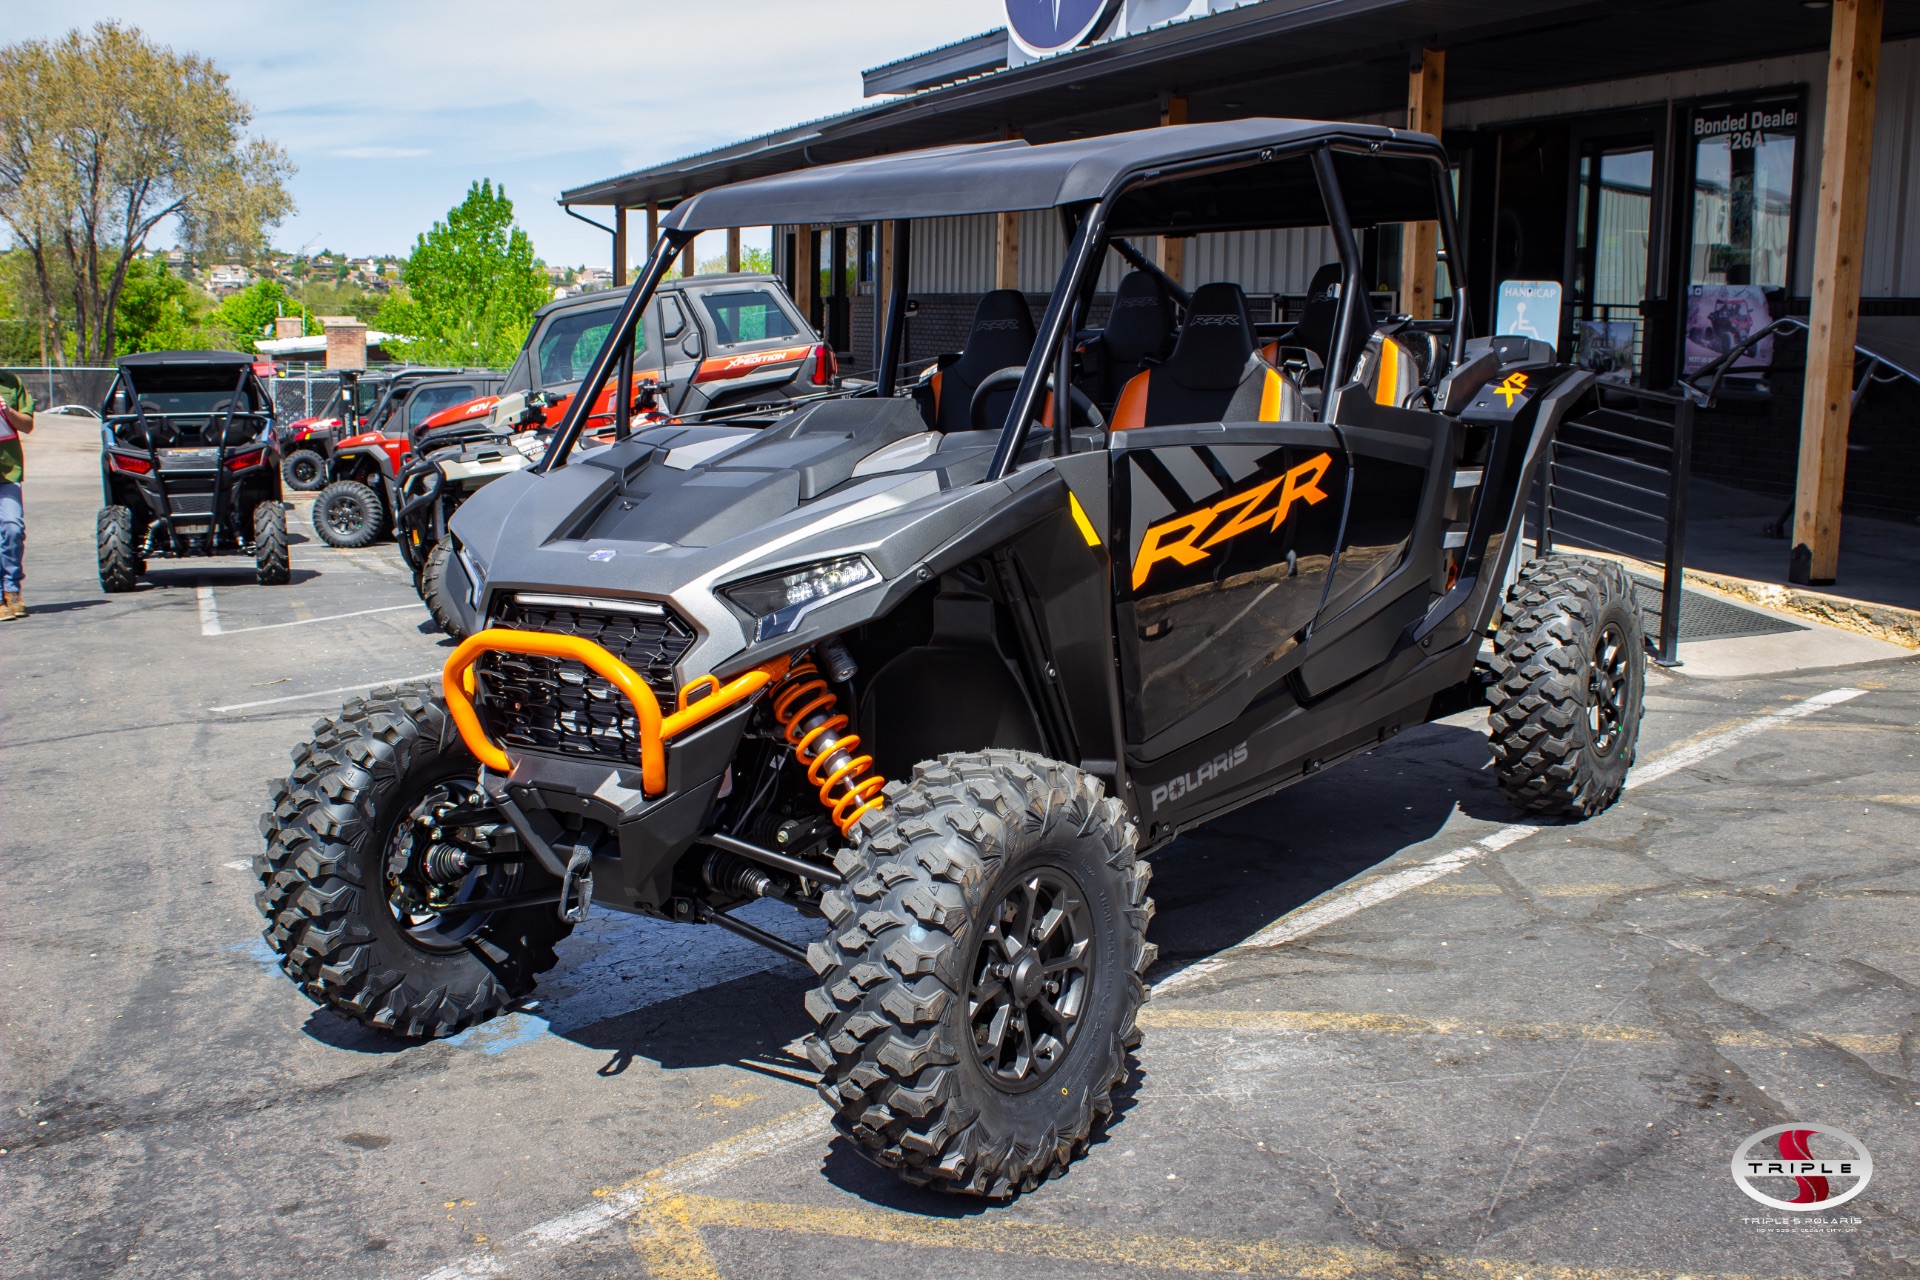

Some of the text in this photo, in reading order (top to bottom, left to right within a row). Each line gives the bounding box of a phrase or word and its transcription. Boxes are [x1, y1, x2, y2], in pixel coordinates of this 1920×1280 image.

[1694, 113, 1747, 135] Bonded
[1504, 287, 1557, 298] HANDICAP
[1189, 314, 1240, 327] RZR
[723, 352, 787, 370] XPEDITION
[1493, 372, 1529, 409] XP
[466, 401, 490, 414] ADV
[1131, 451, 1332, 592] RZR
[1150, 740, 1249, 813] POLARIS
